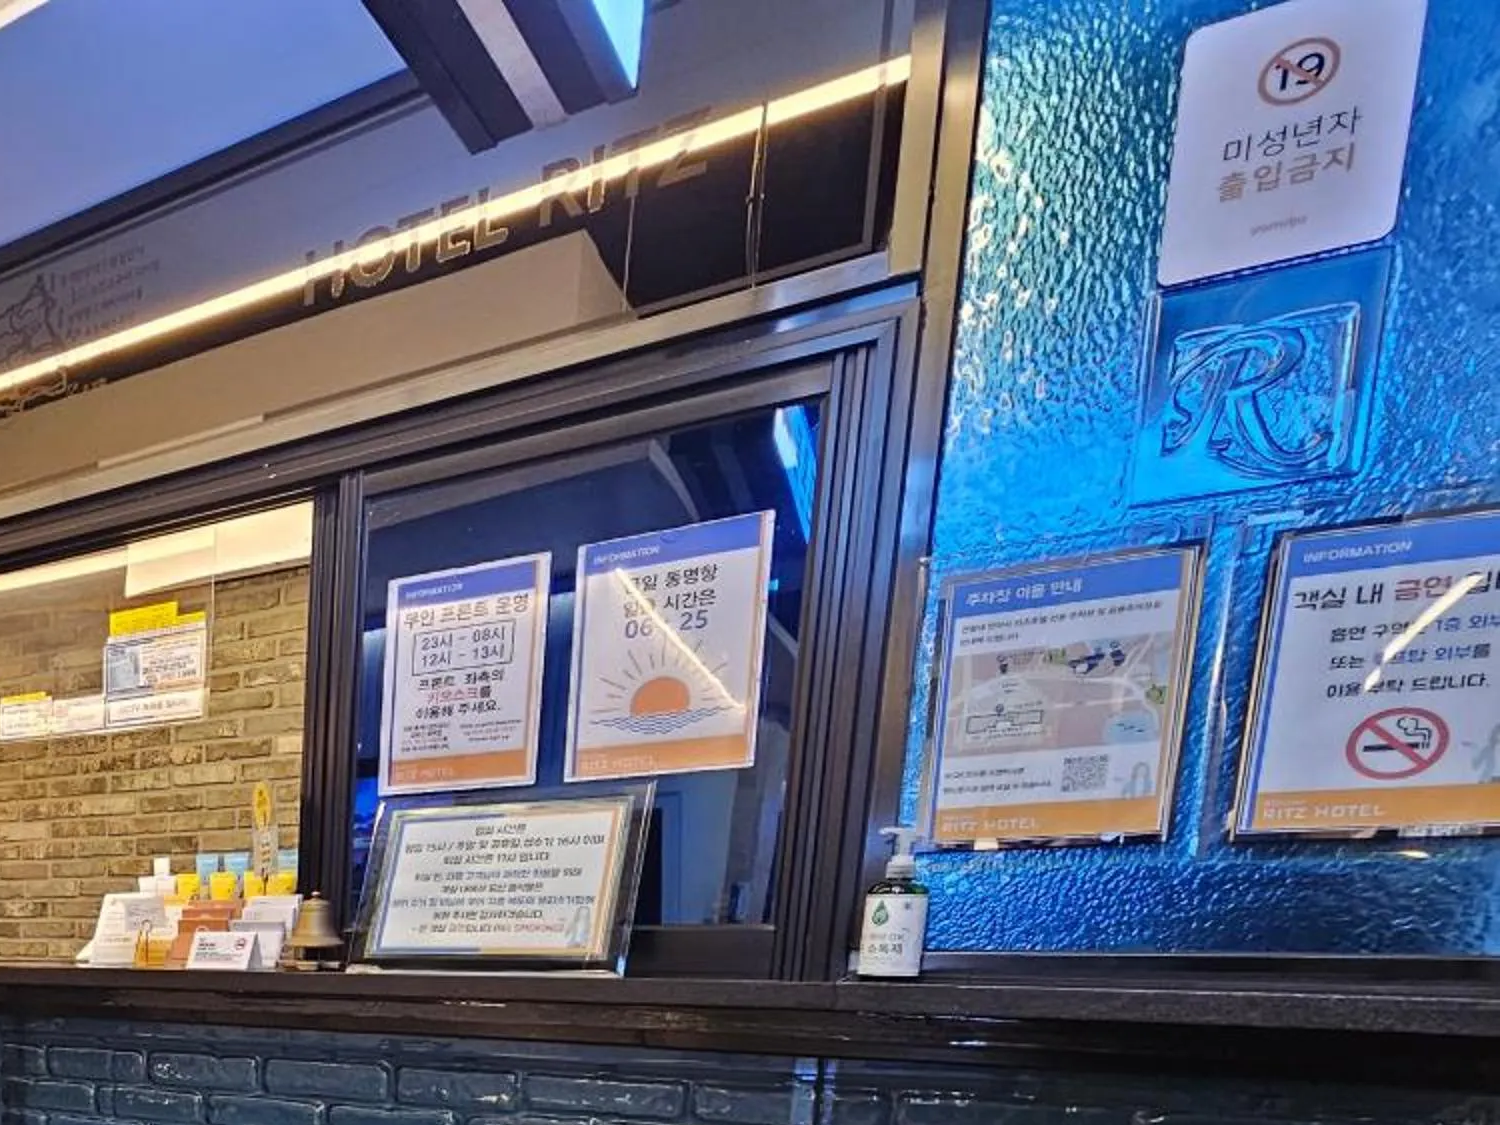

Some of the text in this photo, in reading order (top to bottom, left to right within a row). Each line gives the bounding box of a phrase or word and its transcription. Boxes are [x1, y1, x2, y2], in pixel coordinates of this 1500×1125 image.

[1222, 106, 1364, 162] 미성년자
[1217, 144, 1355, 203] 출입금지
[302, 186, 508, 305] HOTEL
[540, 107, 708, 226] RITZ
[593, 546, 660, 564] INFORMATION
[1303, 541, 1412, 564] INFORMATION
[405, 582, 464, 600] INFORMATION
[664, 588, 717, 611] 시간은
[1016, 583, 1046, 601] 이용
[1051, 578, 1083, 596] 안내
[1295, 586, 1347, 611] 객실
[1357, 582, 1384, 605] 내
[1395, 575, 1453, 601] 금연
[403, 593, 530, 631] 무인 프론트 운영
[680, 609, 709, 631] 25
[420, 632, 454, 651] 23시
[472, 625, 506, 643] 08시
[1330, 625, 1367, 643] 흡연
[421, 650, 451, 668] 12시
[472, 644, 505, 661] 13시
[1329, 655, 1366, 670] 또는
[1435, 643, 1492, 661] 외부를
[427, 685, 493, 704] 키오스크를
[1327, 682, 1362, 699] 이용
[1412, 671, 1490, 692] 드립니다.
[414, 703, 454, 721] 이용해
[1314, 803, 1387, 819] HOTEL
[983, 816, 1038, 832] HOTEL
